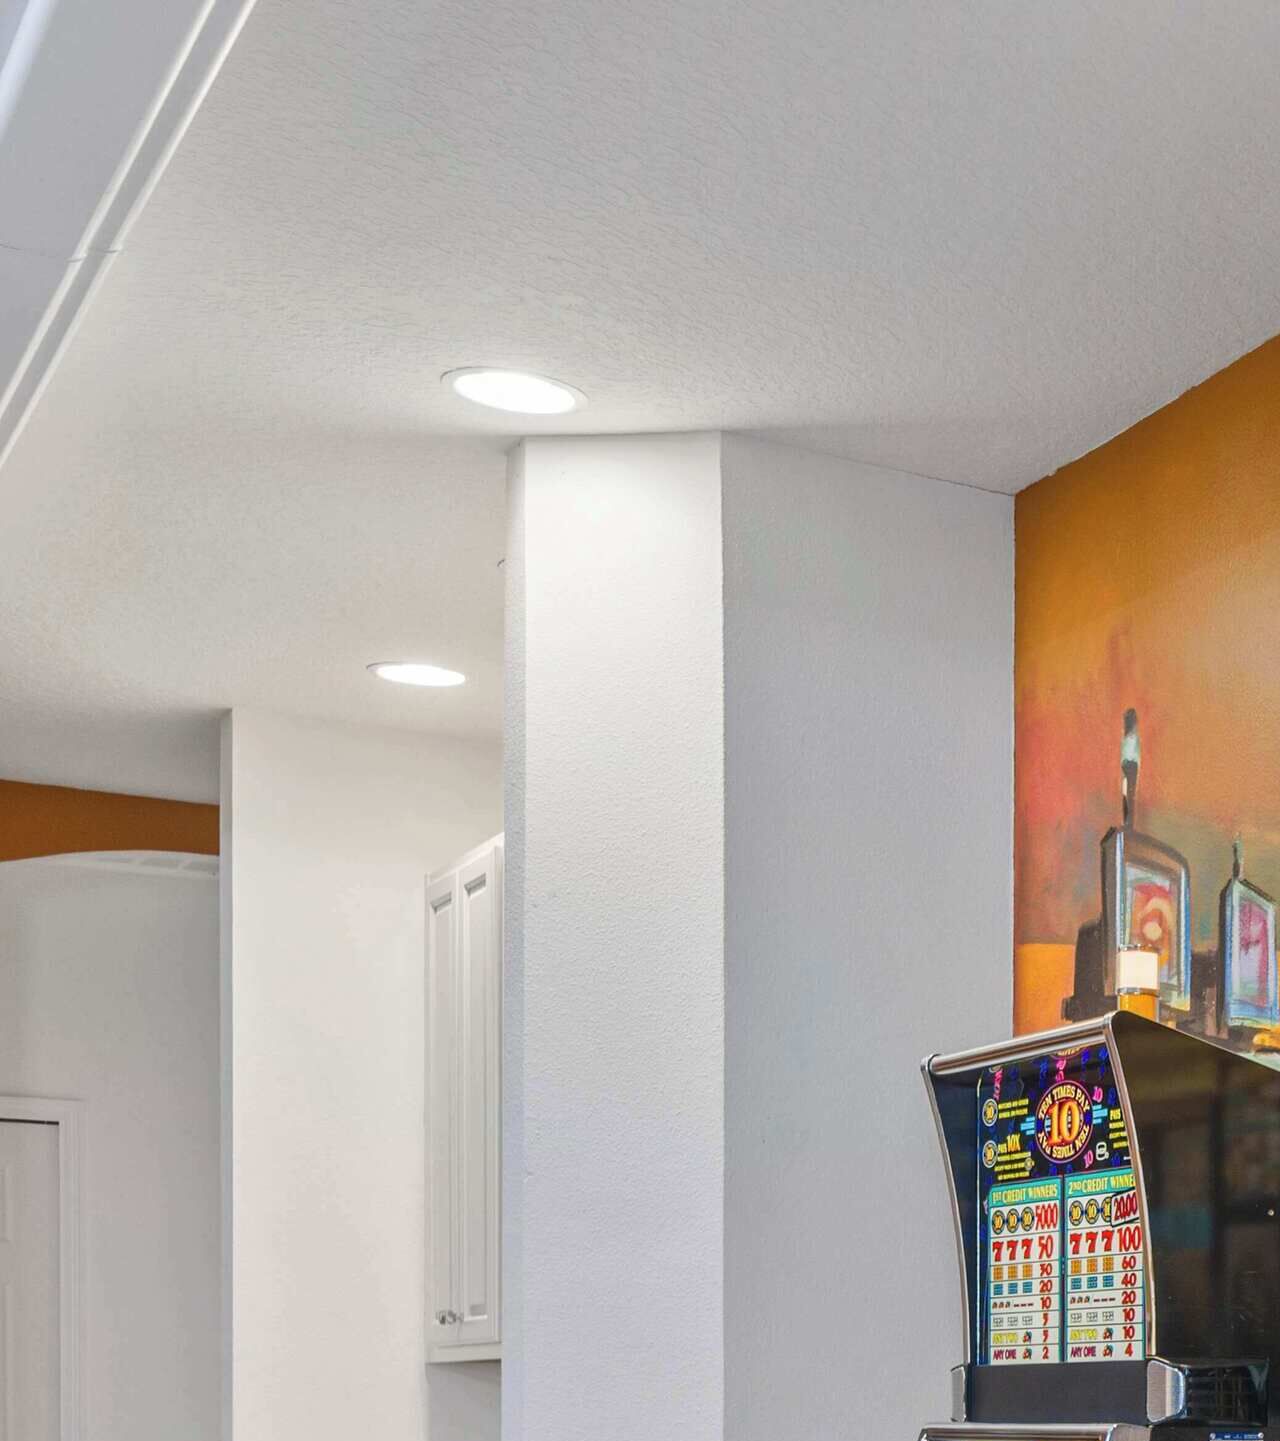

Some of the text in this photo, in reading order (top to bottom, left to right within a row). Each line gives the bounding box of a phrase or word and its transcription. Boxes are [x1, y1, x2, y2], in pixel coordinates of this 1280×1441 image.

[1038, 1092, 1053, 1119] TEN
[1052, 1085, 1076, 1100] TIMES
[1075, 1088, 1091, 1112] PAY
[1046, 1099, 1081, 1147] 10
[1074, 1125, 1090, 1151] TEN
[1052, 1144, 1075, 1159] TIMES
[1082, 1177, 1108, 1193] CREDIT
[1002, 1188, 1026, 1203] CREDIT
[1028, 1184, 1058, 1199] WINNERS
[1035, 1202, 1058, 1231] 5000
[992, 1234, 1053, 1262] 7 7 7 50
[1070, 1226, 1141, 1255] 7 7 7 100
[1121, 1256, 1136, 1270] 60
[1039, 1280, 1052, 1293] 20
[1121, 1273, 1137, 1287] 40
[1040, 1297, 1052, 1309] 10
[1121, 1290, 1136, 1304] 20
[1122, 1308, 1135, 1322] 10
[1123, 1325, 1135, 1339] 10
[993, 1346, 1049, 1360] ANY ONE 2
[1070, 1343, 1133, 1358] ANY ONE 4
